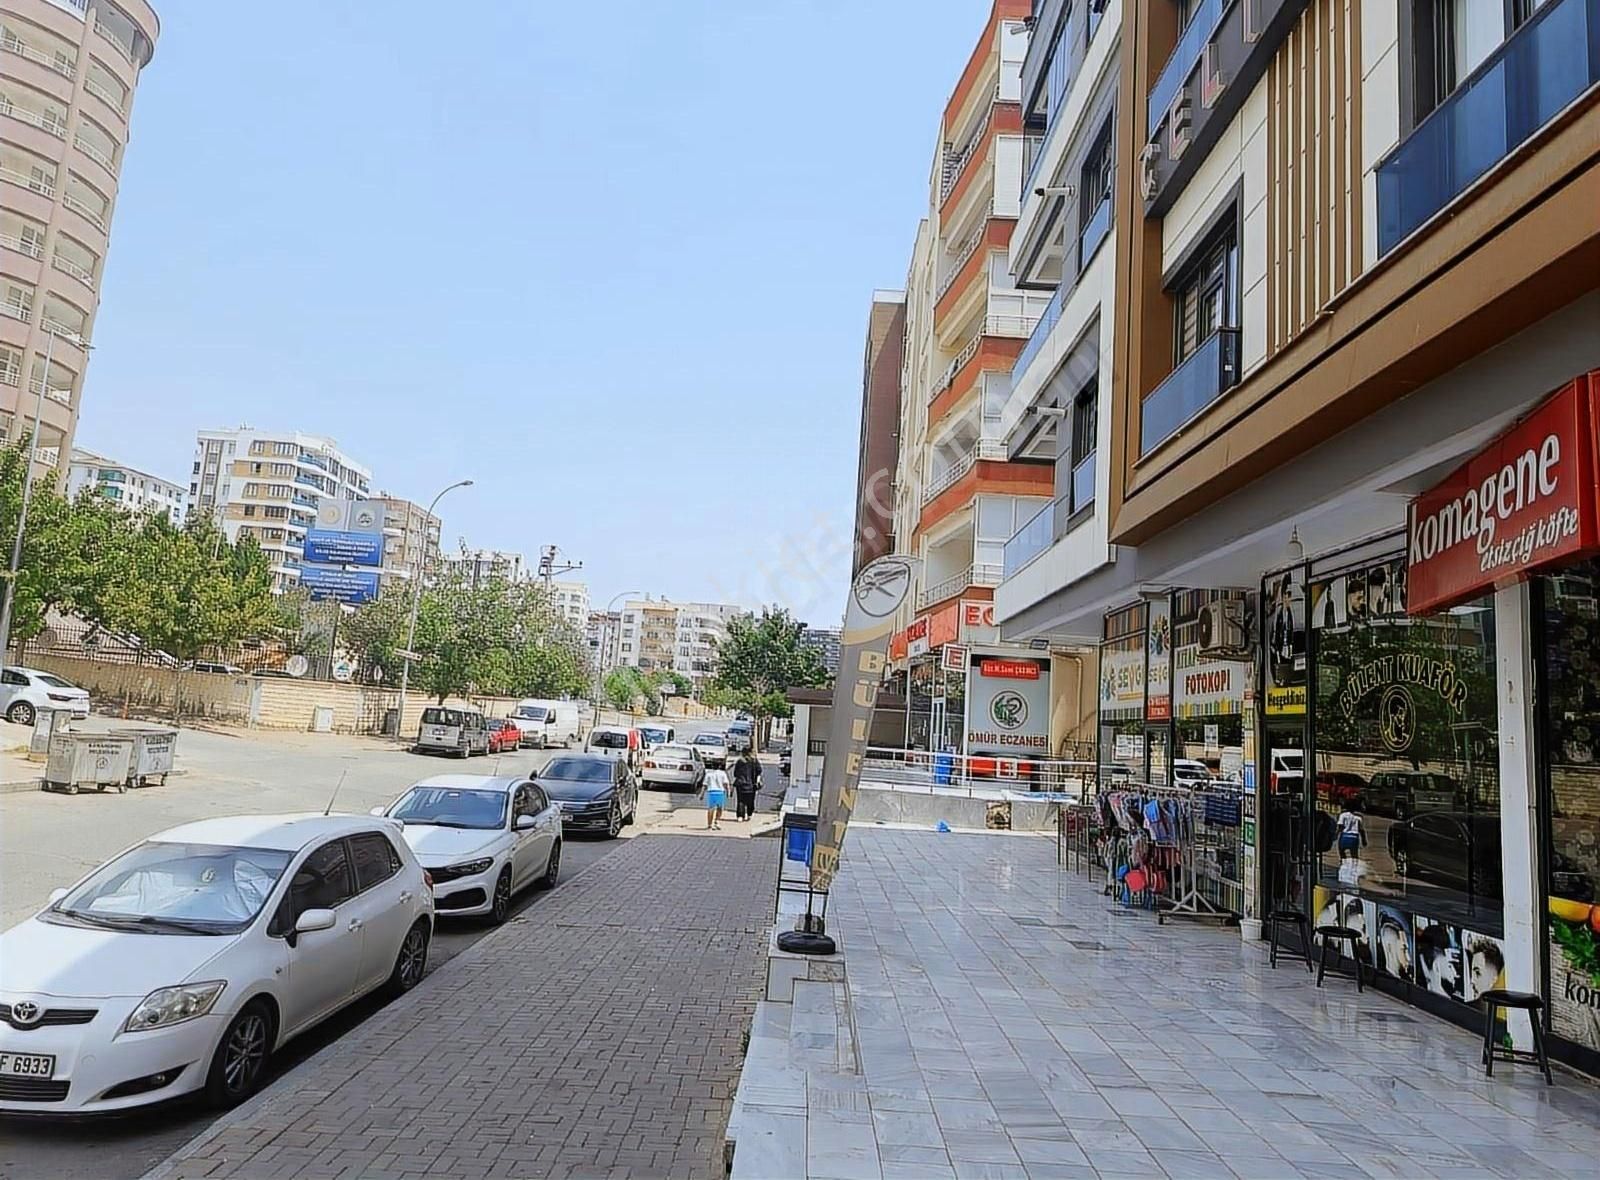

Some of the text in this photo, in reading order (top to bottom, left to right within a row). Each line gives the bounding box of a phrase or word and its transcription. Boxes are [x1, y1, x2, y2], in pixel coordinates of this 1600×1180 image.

[1408, 434, 1560, 567] komagene
[1340, 653, 1468, 718] BÜLENT KUAFÖR
[13, 1056, 50, 1075] 6933
